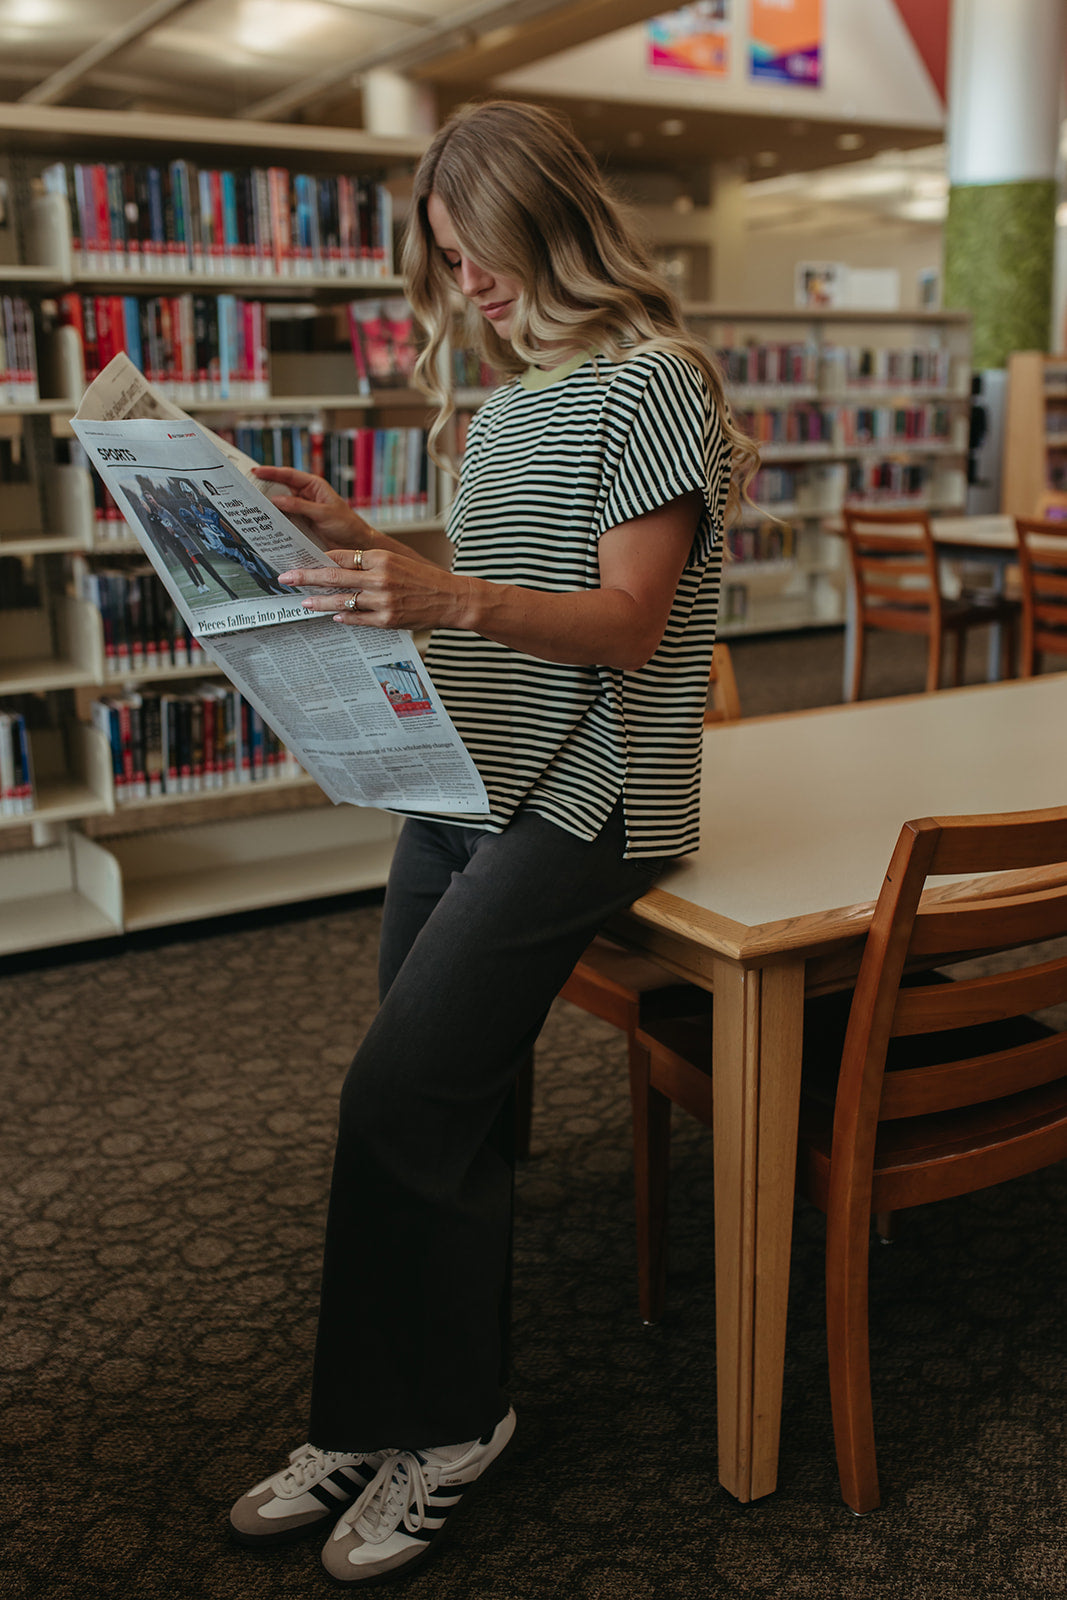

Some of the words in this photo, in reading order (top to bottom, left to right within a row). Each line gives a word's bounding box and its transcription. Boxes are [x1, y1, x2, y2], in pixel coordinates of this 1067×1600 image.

[97, 448, 137, 462] SPORTS
[224, 499, 245, 509] really
[240, 507, 262, 516] going
[252, 512, 271, 524] pool
[241, 526, 260, 534] every
[198, 620, 227, 632] Pieces
[226, 612, 257, 627] falling
[257, 610, 276, 623] into
[276, 607, 302, 622] place
